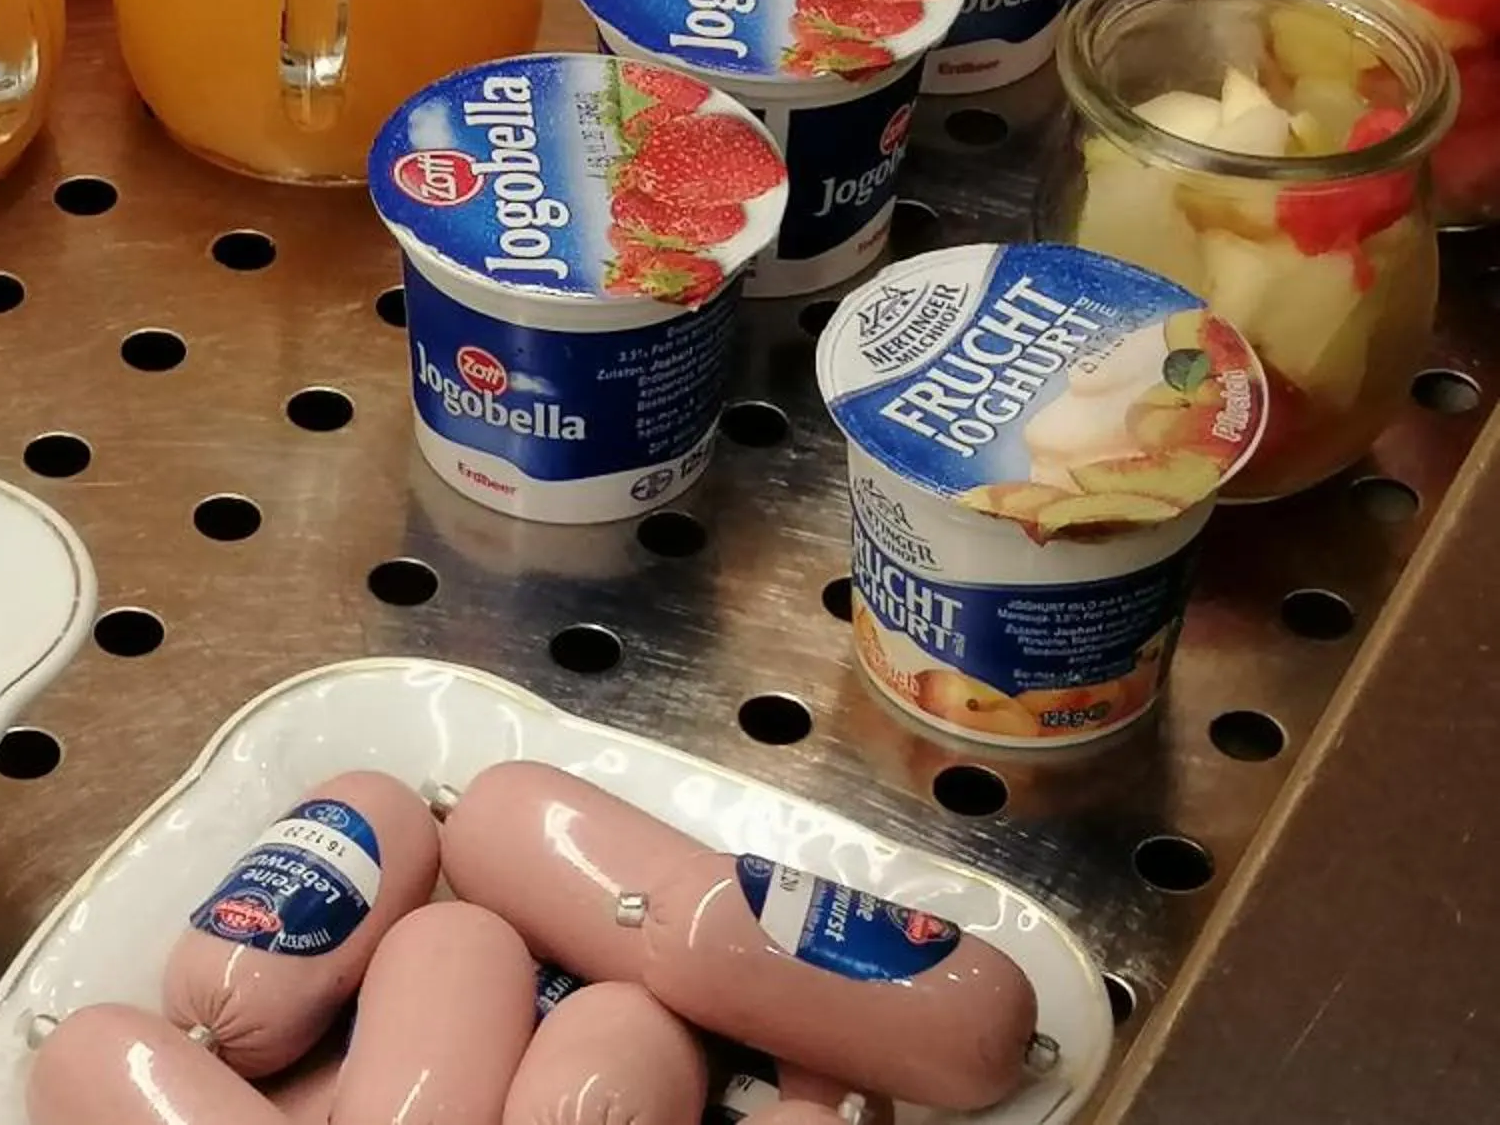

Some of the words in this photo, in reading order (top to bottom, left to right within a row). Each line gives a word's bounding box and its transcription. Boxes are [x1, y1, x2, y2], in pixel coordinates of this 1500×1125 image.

[463, 74, 569, 280] Jogobella
[861, 283, 960, 367] MERTINGER
[879, 276, 1068, 438] FRUCHT
[894, 299, 961, 365] MILCHHOF
[416, 340, 588, 441] Jogobella
[934, 305, 1101, 458] JOGHURT
[242, 867, 300, 896] Feine
